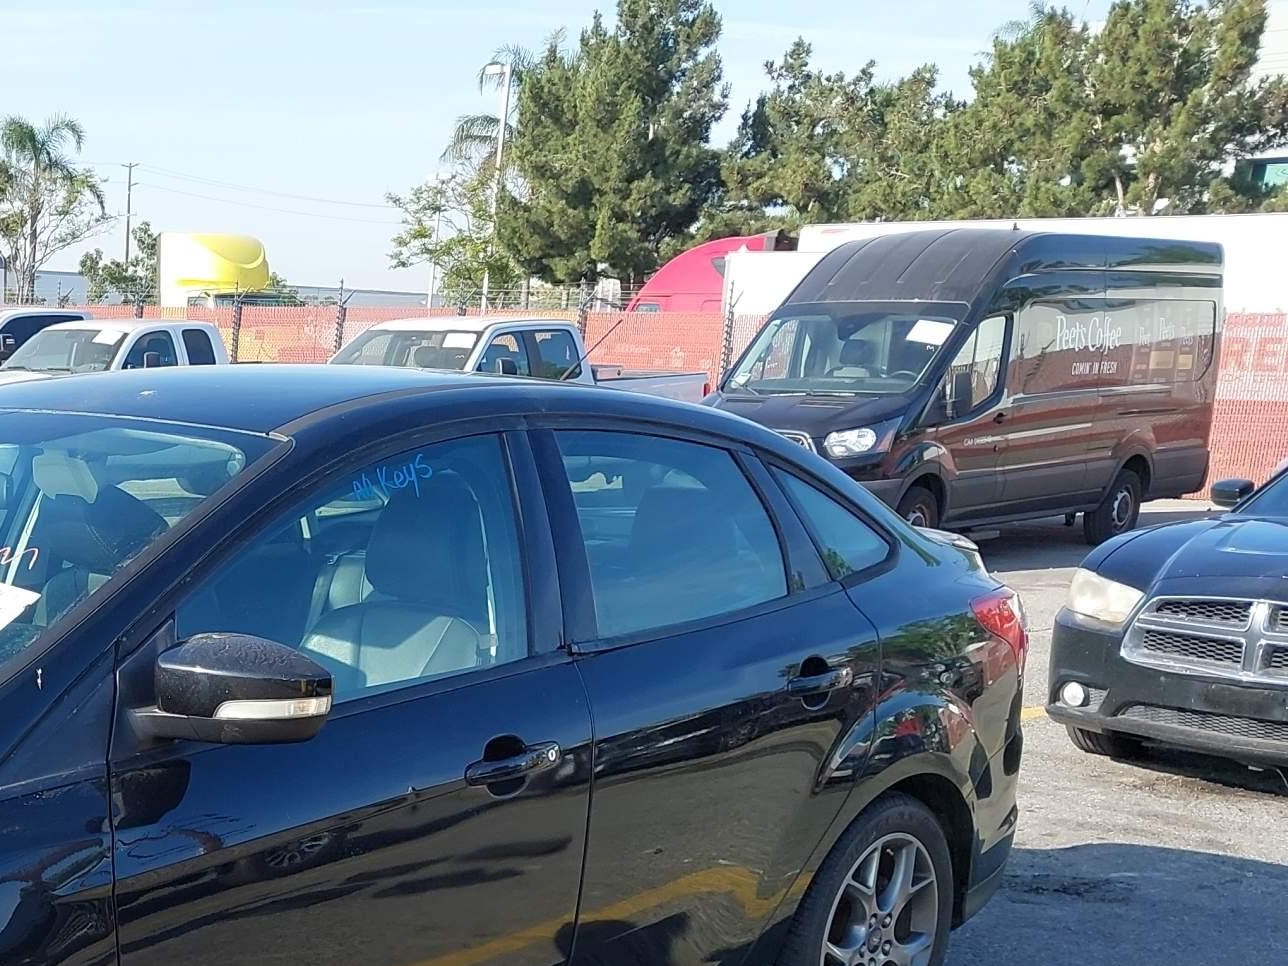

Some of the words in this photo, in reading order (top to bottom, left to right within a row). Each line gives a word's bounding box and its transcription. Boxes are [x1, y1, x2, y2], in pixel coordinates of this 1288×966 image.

[1088, 316, 1122, 355] Coffee
[1100, 361, 1119, 375] FRESH
[375, 454, 433, 498] Keys
